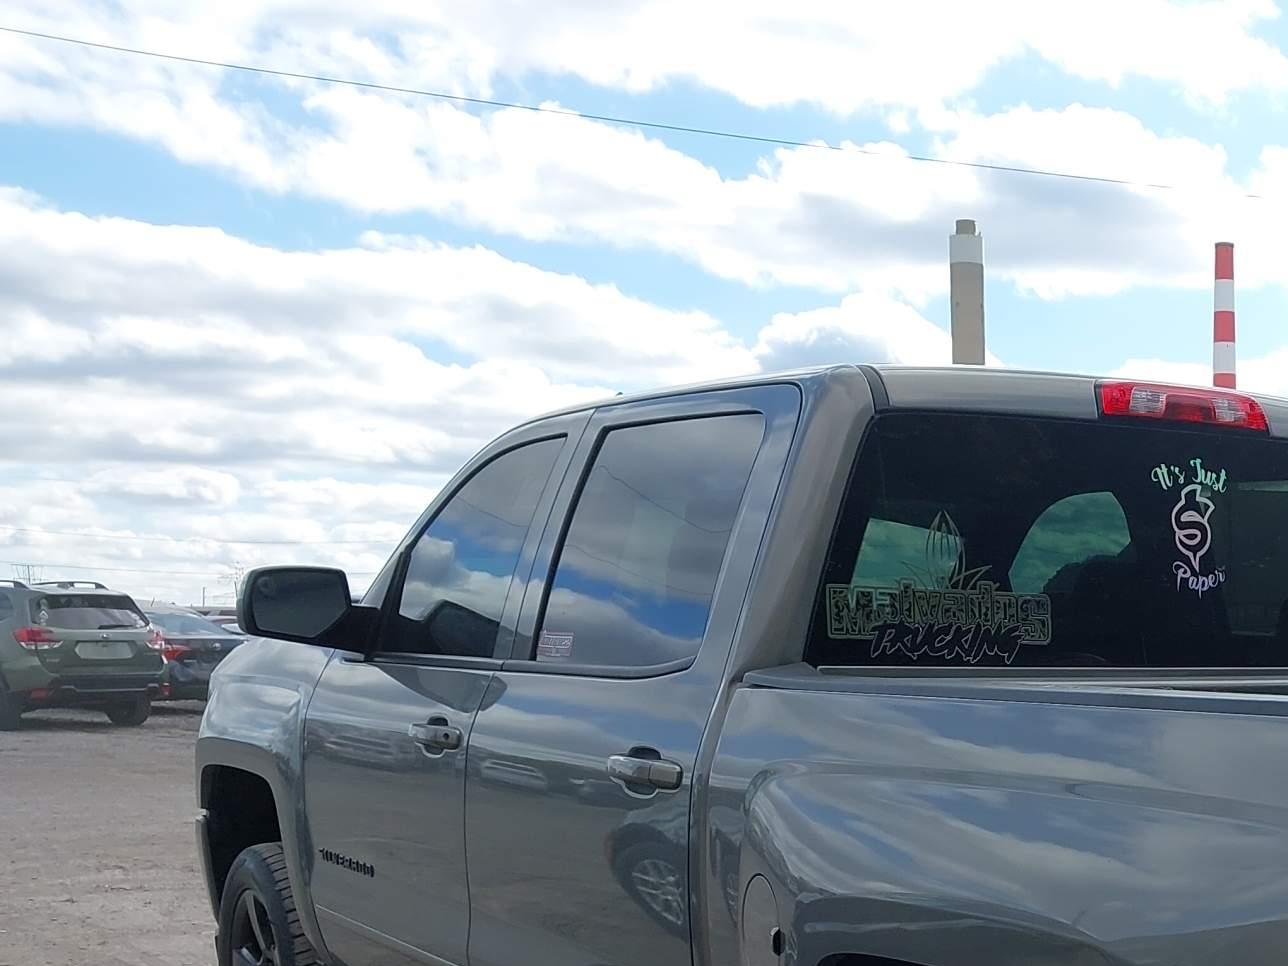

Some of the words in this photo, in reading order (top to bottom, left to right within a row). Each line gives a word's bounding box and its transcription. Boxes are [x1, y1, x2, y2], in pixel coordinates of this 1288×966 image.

[1151, 463, 1185, 491] It's
[1189, 458, 1227, 493] Just
[1172, 561, 1226, 600] Paper
